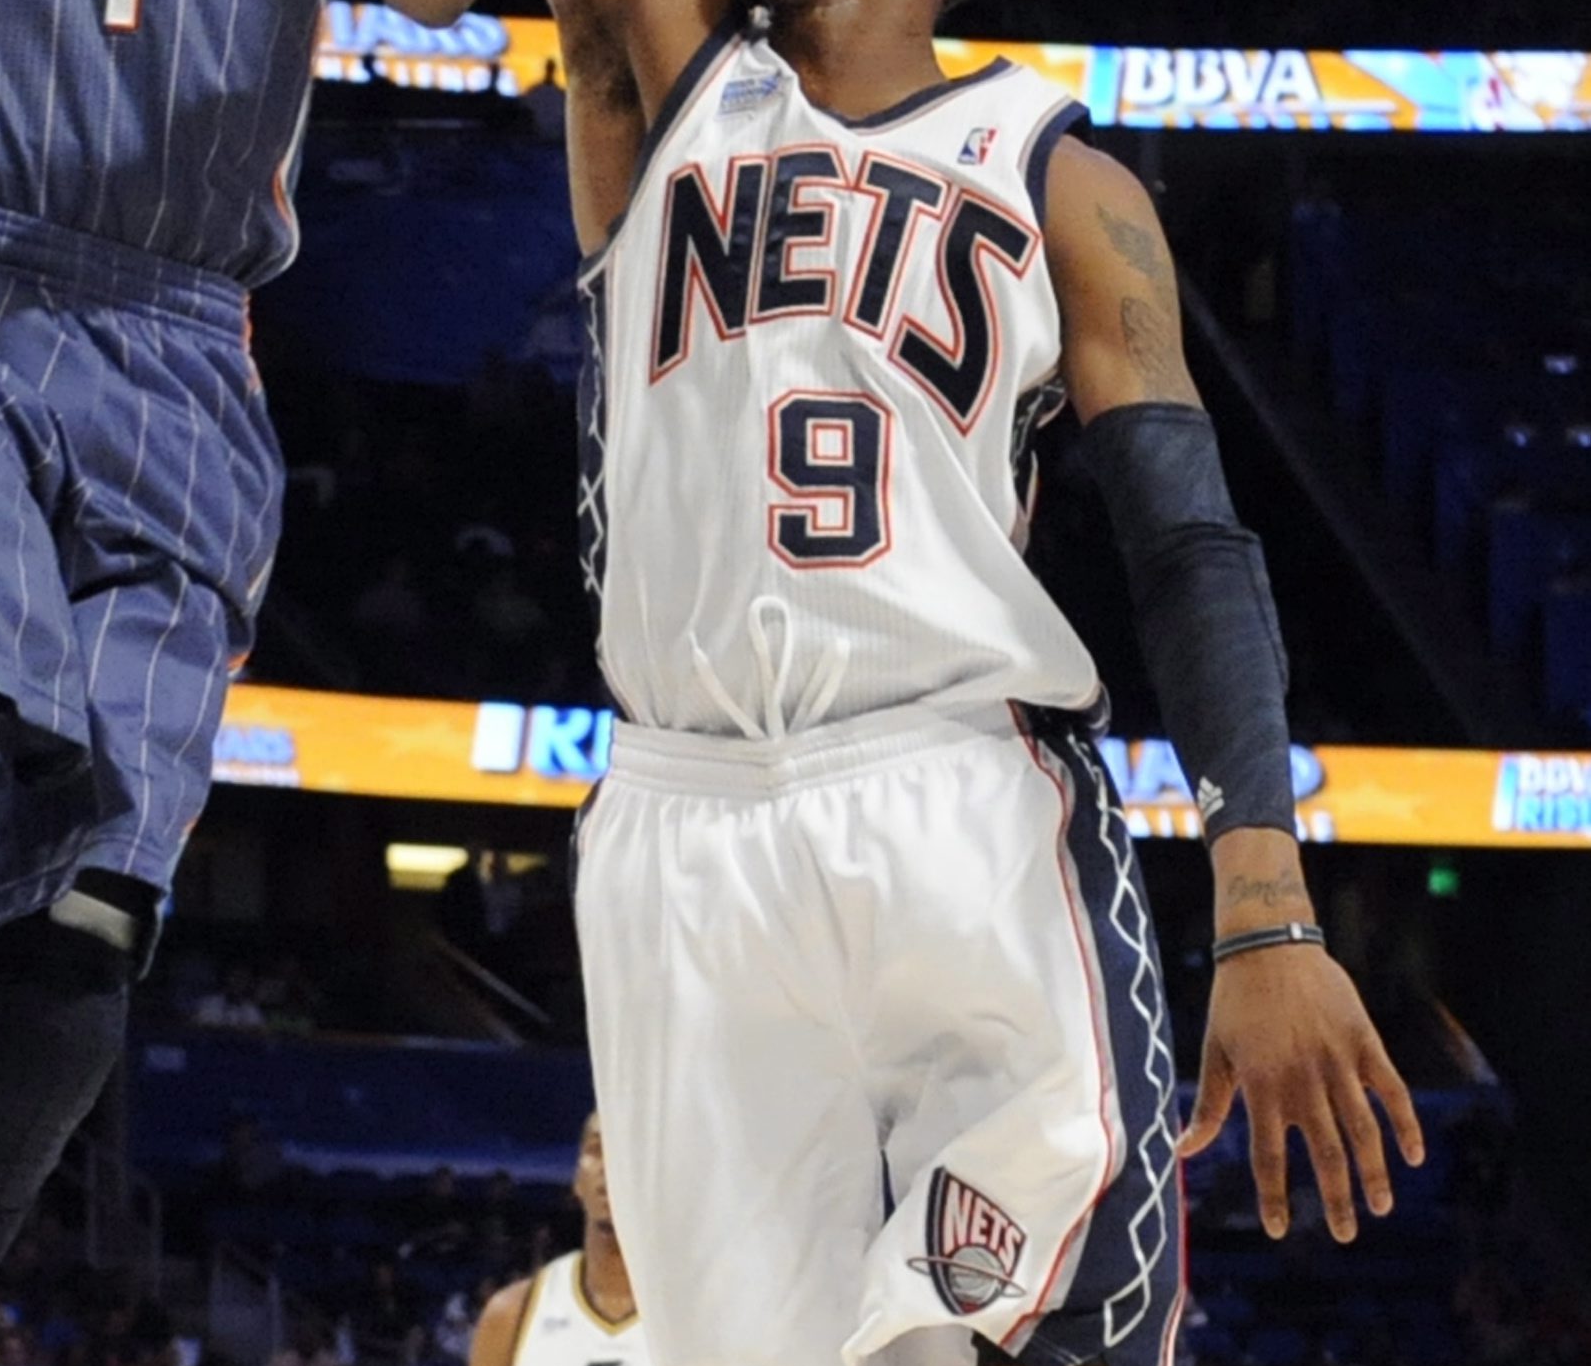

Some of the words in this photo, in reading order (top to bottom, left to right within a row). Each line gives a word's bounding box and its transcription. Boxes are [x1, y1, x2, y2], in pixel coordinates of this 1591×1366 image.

[1121, 47, 1323, 107] BBVA
[649, 142, 1045, 438] NETS
[766, 388, 892, 570] 9
[942, 1177, 1024, 1278] NETS
